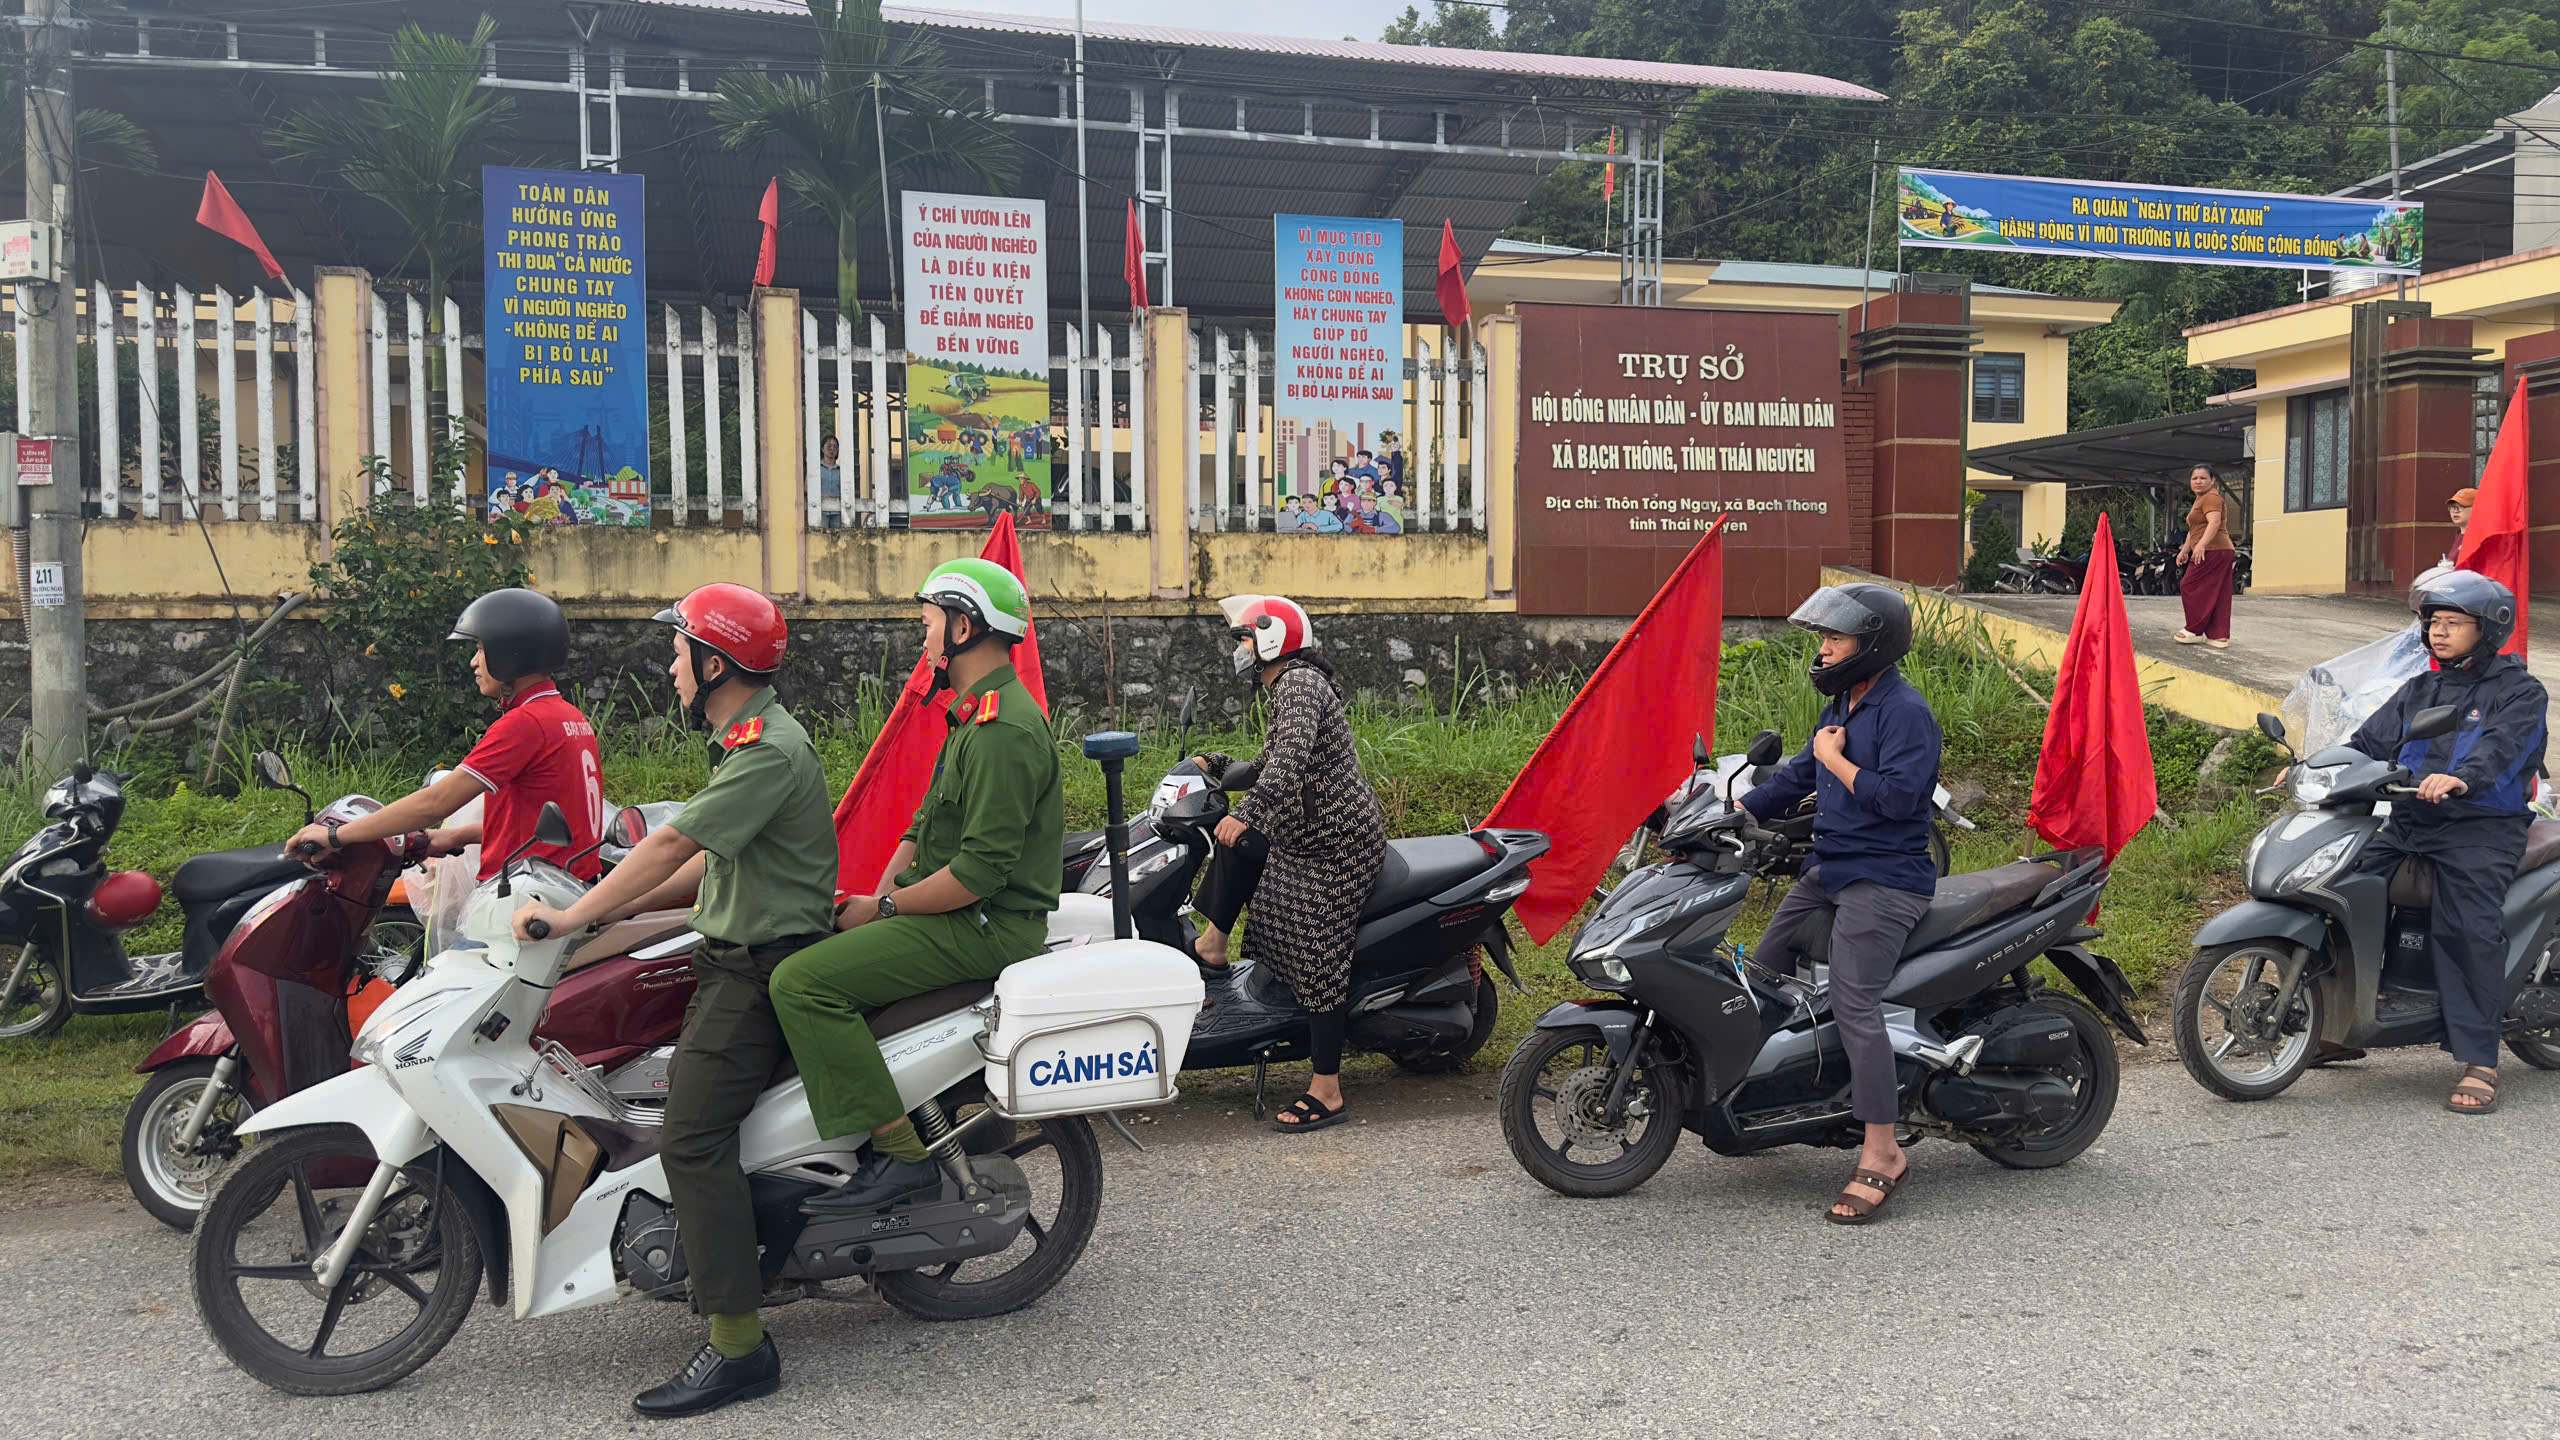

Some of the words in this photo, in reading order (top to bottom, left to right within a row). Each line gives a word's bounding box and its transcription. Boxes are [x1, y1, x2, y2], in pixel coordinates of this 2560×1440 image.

[519, 184, 566, 203] TOÀN
[574, 186, 609, 206] DÂN
[512, 204, 573, 226] HƯỞNG
[581, 208, 616, 229] ỨNG
[919, 203, 927, 221] Ý
[932, 206, 956, 223] CHÍ
[961, 209, 999, 227] VƯƠN
[1004, 210, 1031, 228] LÊN
[2072, 197, 2089, 215] RA
[2093, 197, 2128, 218] QUÂN
[2176, 202, 2200, 222] THỨ
[2203, 202, 2226, 225] BẢY
[508, 230, 568, 248] PHONG
[576, 232, 621, 252] TRÀO
[913, 228, 941, 248] CỦA
[945, 233, 987, 251] NGƯỜI
[992, 235, 1037, 254] NGHÈO
[1298, 227, 1311, 243] VÌ
[1317, 230, 1346, 247] MỤC
[2000, 216, 2035, 239] HÀNH
[2039, 219, 2074, 243] ĐỘNG
[2078, 221, 2090, 242] VÌ
[2094, 223, 2118, 244] MÔI
[2122, 226, 2171, 247] TRƯỜNG
[2175, 228, 2191, 248] VÀ
[2194, 230, 2227, 254] CUỘC
[2231, 230, 2264, 253] SỐNG
[2268, 234, 2300, 258] CỘNG
[2304, 234, 2337, 257] ĐỒNG
[497, 252, 520, 269] THI
[525, 254, 556, 271] ĐUA
[590, 258, 632, 275] NƯỚC
[922, 256, 941, 274] LÀ
[993, 261, 1030, 282] KIỆN
[1338, 251, 1374, 268] DỰNG
[516, 276, 578, 295] CHUNG
[586, 280, 615, 296] TAY
[1301, 267, 1337, 285] CỘNG
[929, 283, 966, 301] TIÊN
[974, 284, 1024, 305] QUYẾT
[1285, 286, 1324, 301] KHÔNG
[504, 296, 518, 315] VÌ
[523, 297, 571, 318] NGƯỜI
[576, 301, 627, 320] NGHÈO
[920, 305, 939, 325] ĐỂ
[944, 307, 981, 328] GIẢM
[986, 312, 1033, 330] NGHÈO
[1294, 305, 1317, 320] HÃY
[1322, 308, 1363, 322] CHUNG
[1368, 311, 1387, 323] TAY
[576, 319, 597, 341] ĐỂ
[602, 326, 618, 341] AI
[1314, 326, 1344, 341] GIÚP
[525, 344, 542, 364] BỊ
[550, 342, 573, 362] BỎ
[581, 348, 608, 367] LẠI
[976, 336, 1019, 355] VỮNG
[1293, 344, 1334, 360] NGƯỜI
[520, 366, 562, 384] PHÍA
[1297, 363, 1343, 379] KHÔNG
[1349, 362, 1365, 380] ĐỂ
[1371, 368, 1384, 381] AI
[1618, 353, 1689, 385] TRỤ
[1699, 344, 1745, 381] SỞ
[1288, 384, 1299, 400] BỊ
[1303, 381, 1317, 398] BỎ
[1321, 386, 1338, 402] LẠI
[1342, 384, 1368, 399] PHÍA
[1372, 387, 1393, 400] SAU
[1532, 392, 1558, 427] HỘI
[1562, 388, 1604, 423] ĐỒNG
[1608, 394, 1650, 424] NHÂN
[1654, 395, 1685, 425] DÂN
[1701, 392, 1720, 426] ỦY
[1724, 402, 1754, 426] BAN
[1759, 397, 1798, 427] NHÂN
[1803, 398, 1835, 428] DÂN
[1552, 439, 1574, 469] XÃ
[1578, 444, 1619, 474] BẠCH
[1623, 440, 1678, 474] THÔNG,
[1681, 437, 1716, 471] TỈNH
[1719, 443, 1752, 472] THÁI
[1756, 443, 1815, 473] NGUYÊN
[1546, 496, 1571, 511] Địa
[1605, 496, 1638, 509] Thôn
[1642, 493, 1677, 512] Tổng
[1681, 498, 1720, 513] Ngay,
[1725, 498, 1743, 510] xã
[1747, 499, 1782, 514] Bạch
[1629, 516, 1656, 530] tỉnh
[1660, 516, 1690, 530] Thái
[1694, 518, 1748, 533] Ngyên
[1305, 773, 1320, 783] Dior
[582, 749, 600, 839] 6
[1311, 881, 1327, 892] Dior
[1302, 902, 1316, 913] Dior
[1304, 915, 1320, 925] Dior
[1300, 949, 1315, 960] Dior
[884, 1026, 958, 1065] TURE
[395, 1056, 435, 1070] HONDA
[1030, 1050, 1113, 1087] CẢNH
